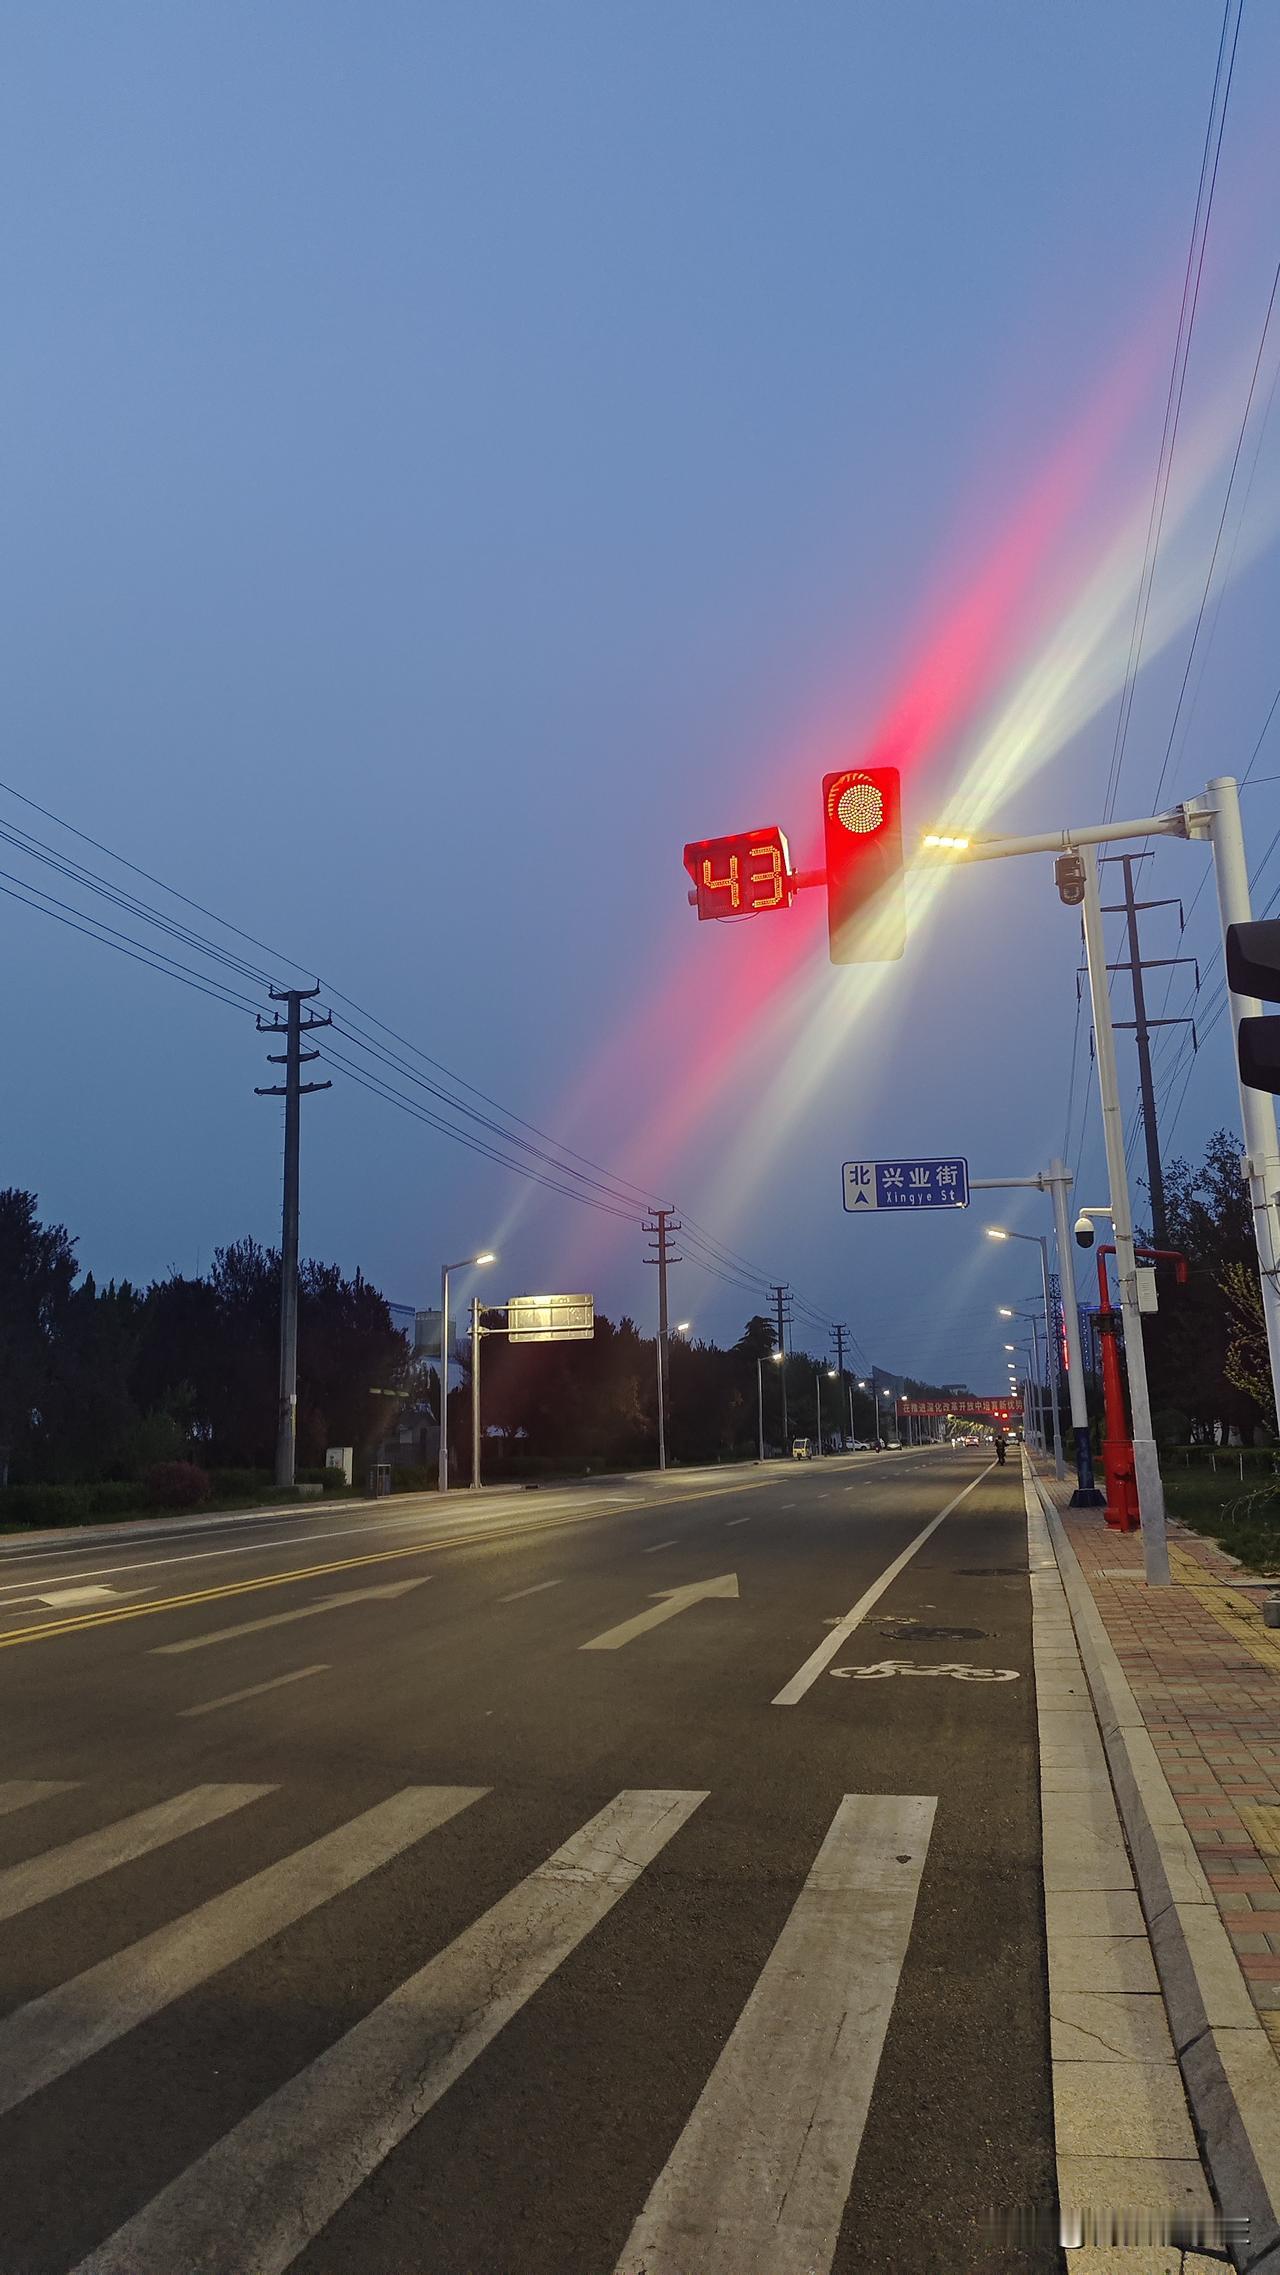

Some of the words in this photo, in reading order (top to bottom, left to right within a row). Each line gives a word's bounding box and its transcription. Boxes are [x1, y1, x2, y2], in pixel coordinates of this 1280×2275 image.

[703, 845, 783, 908] 43
[850, 1165, 871, 1186] 北
[882, 1165, 958, 1188] 兴业街
[886, 1191, 932, 1204] Xingye
[941, 1189, 955, 1201] St
